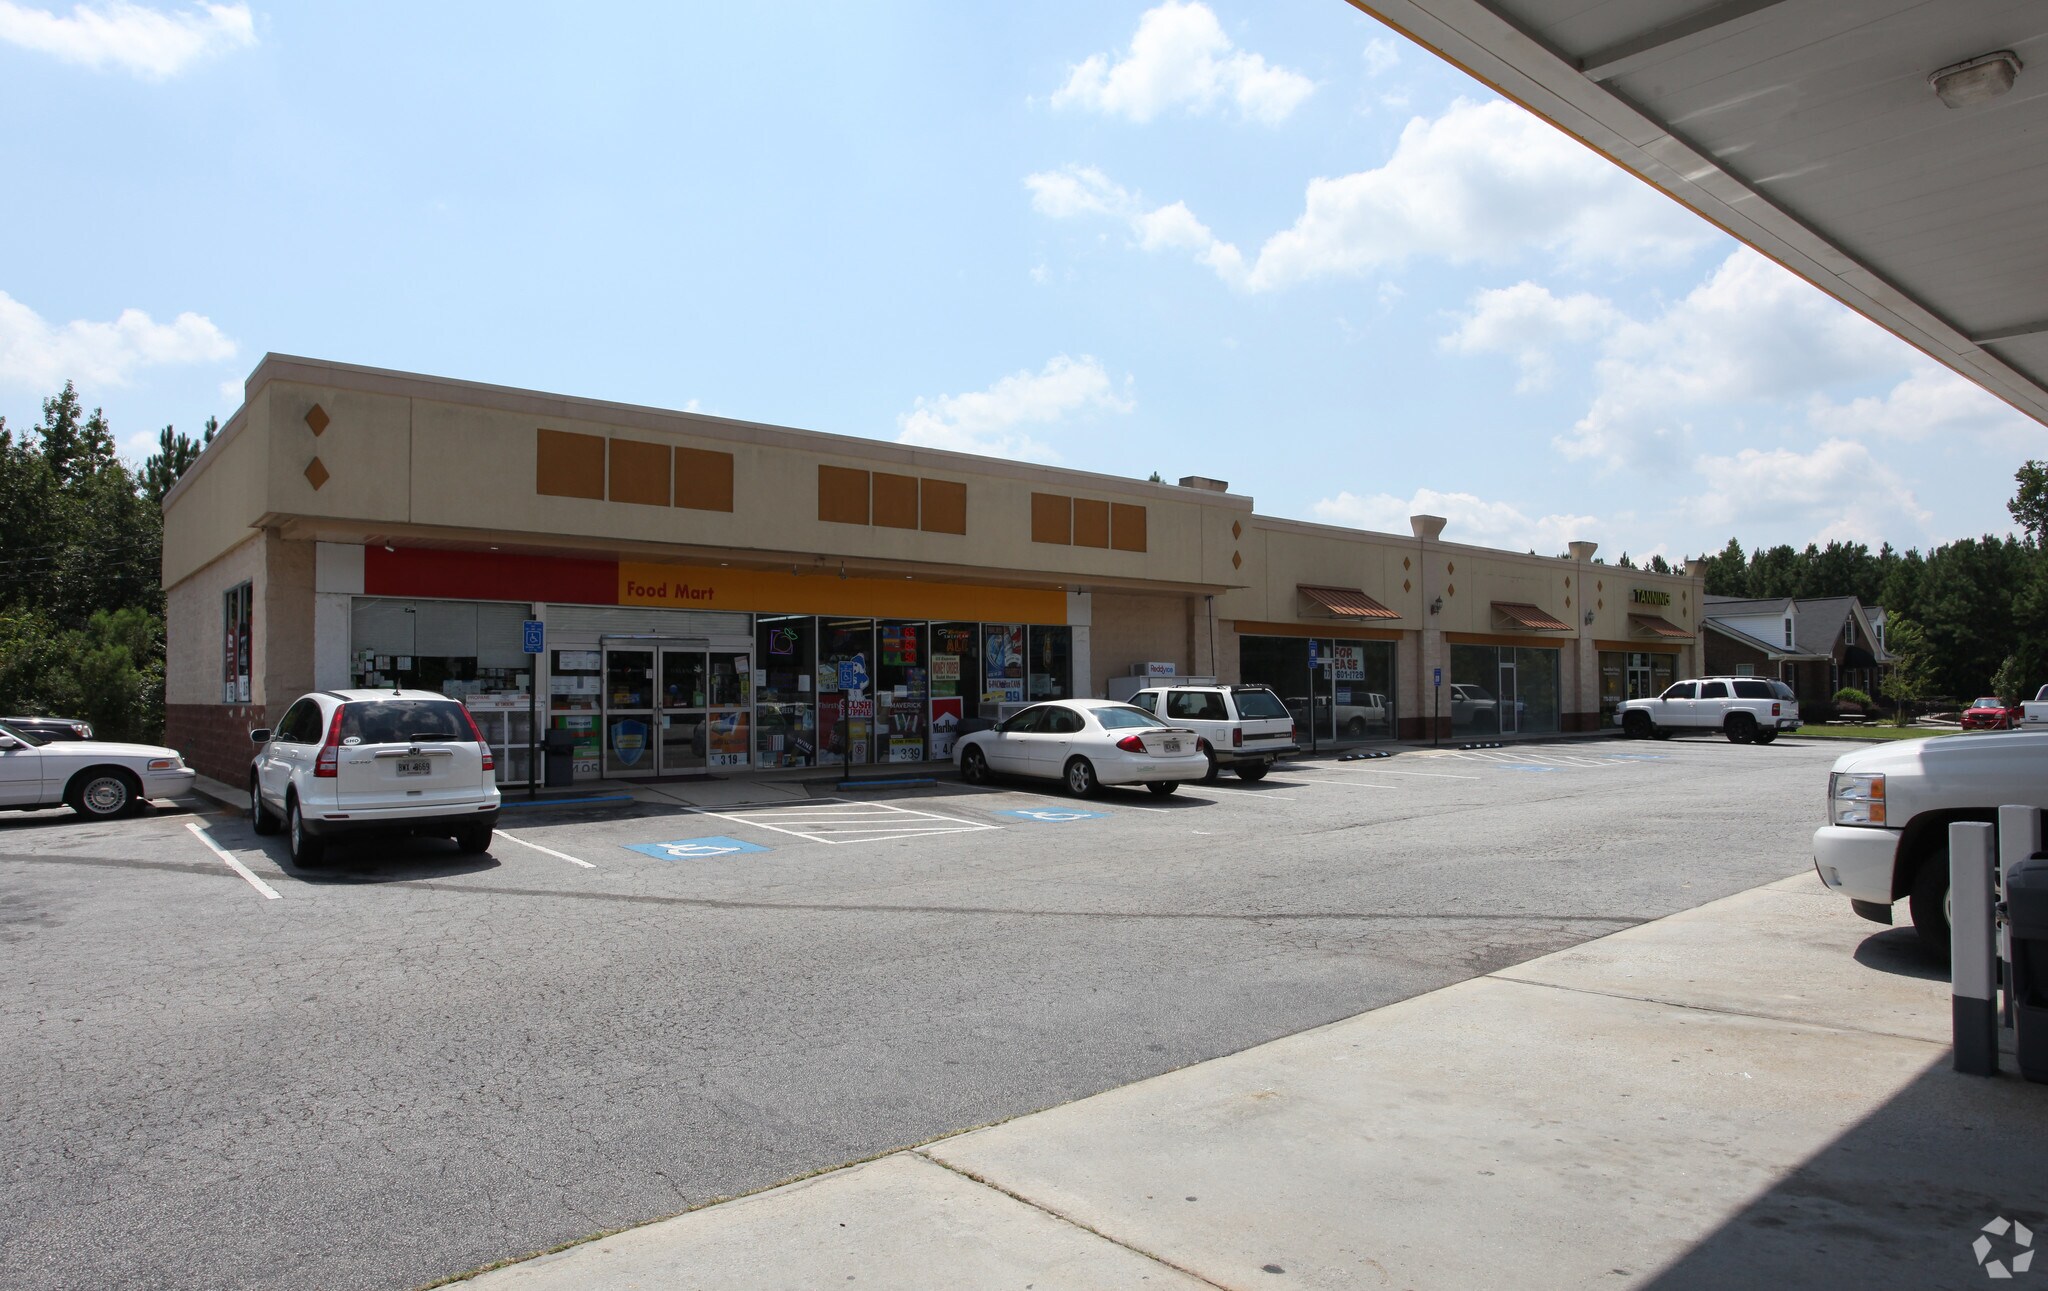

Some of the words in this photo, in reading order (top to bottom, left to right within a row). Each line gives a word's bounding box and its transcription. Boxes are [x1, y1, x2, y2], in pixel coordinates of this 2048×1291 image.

[627, 581, 667, 598] Food
[674, 583, 714, 600] Mart
[1634, 588, 1671, 607] TANNING
[1335, 647, 1353, 658] FOR
[889, 702, 922, 710] MAVERICK
[796, 737, 814, 752] WINE
